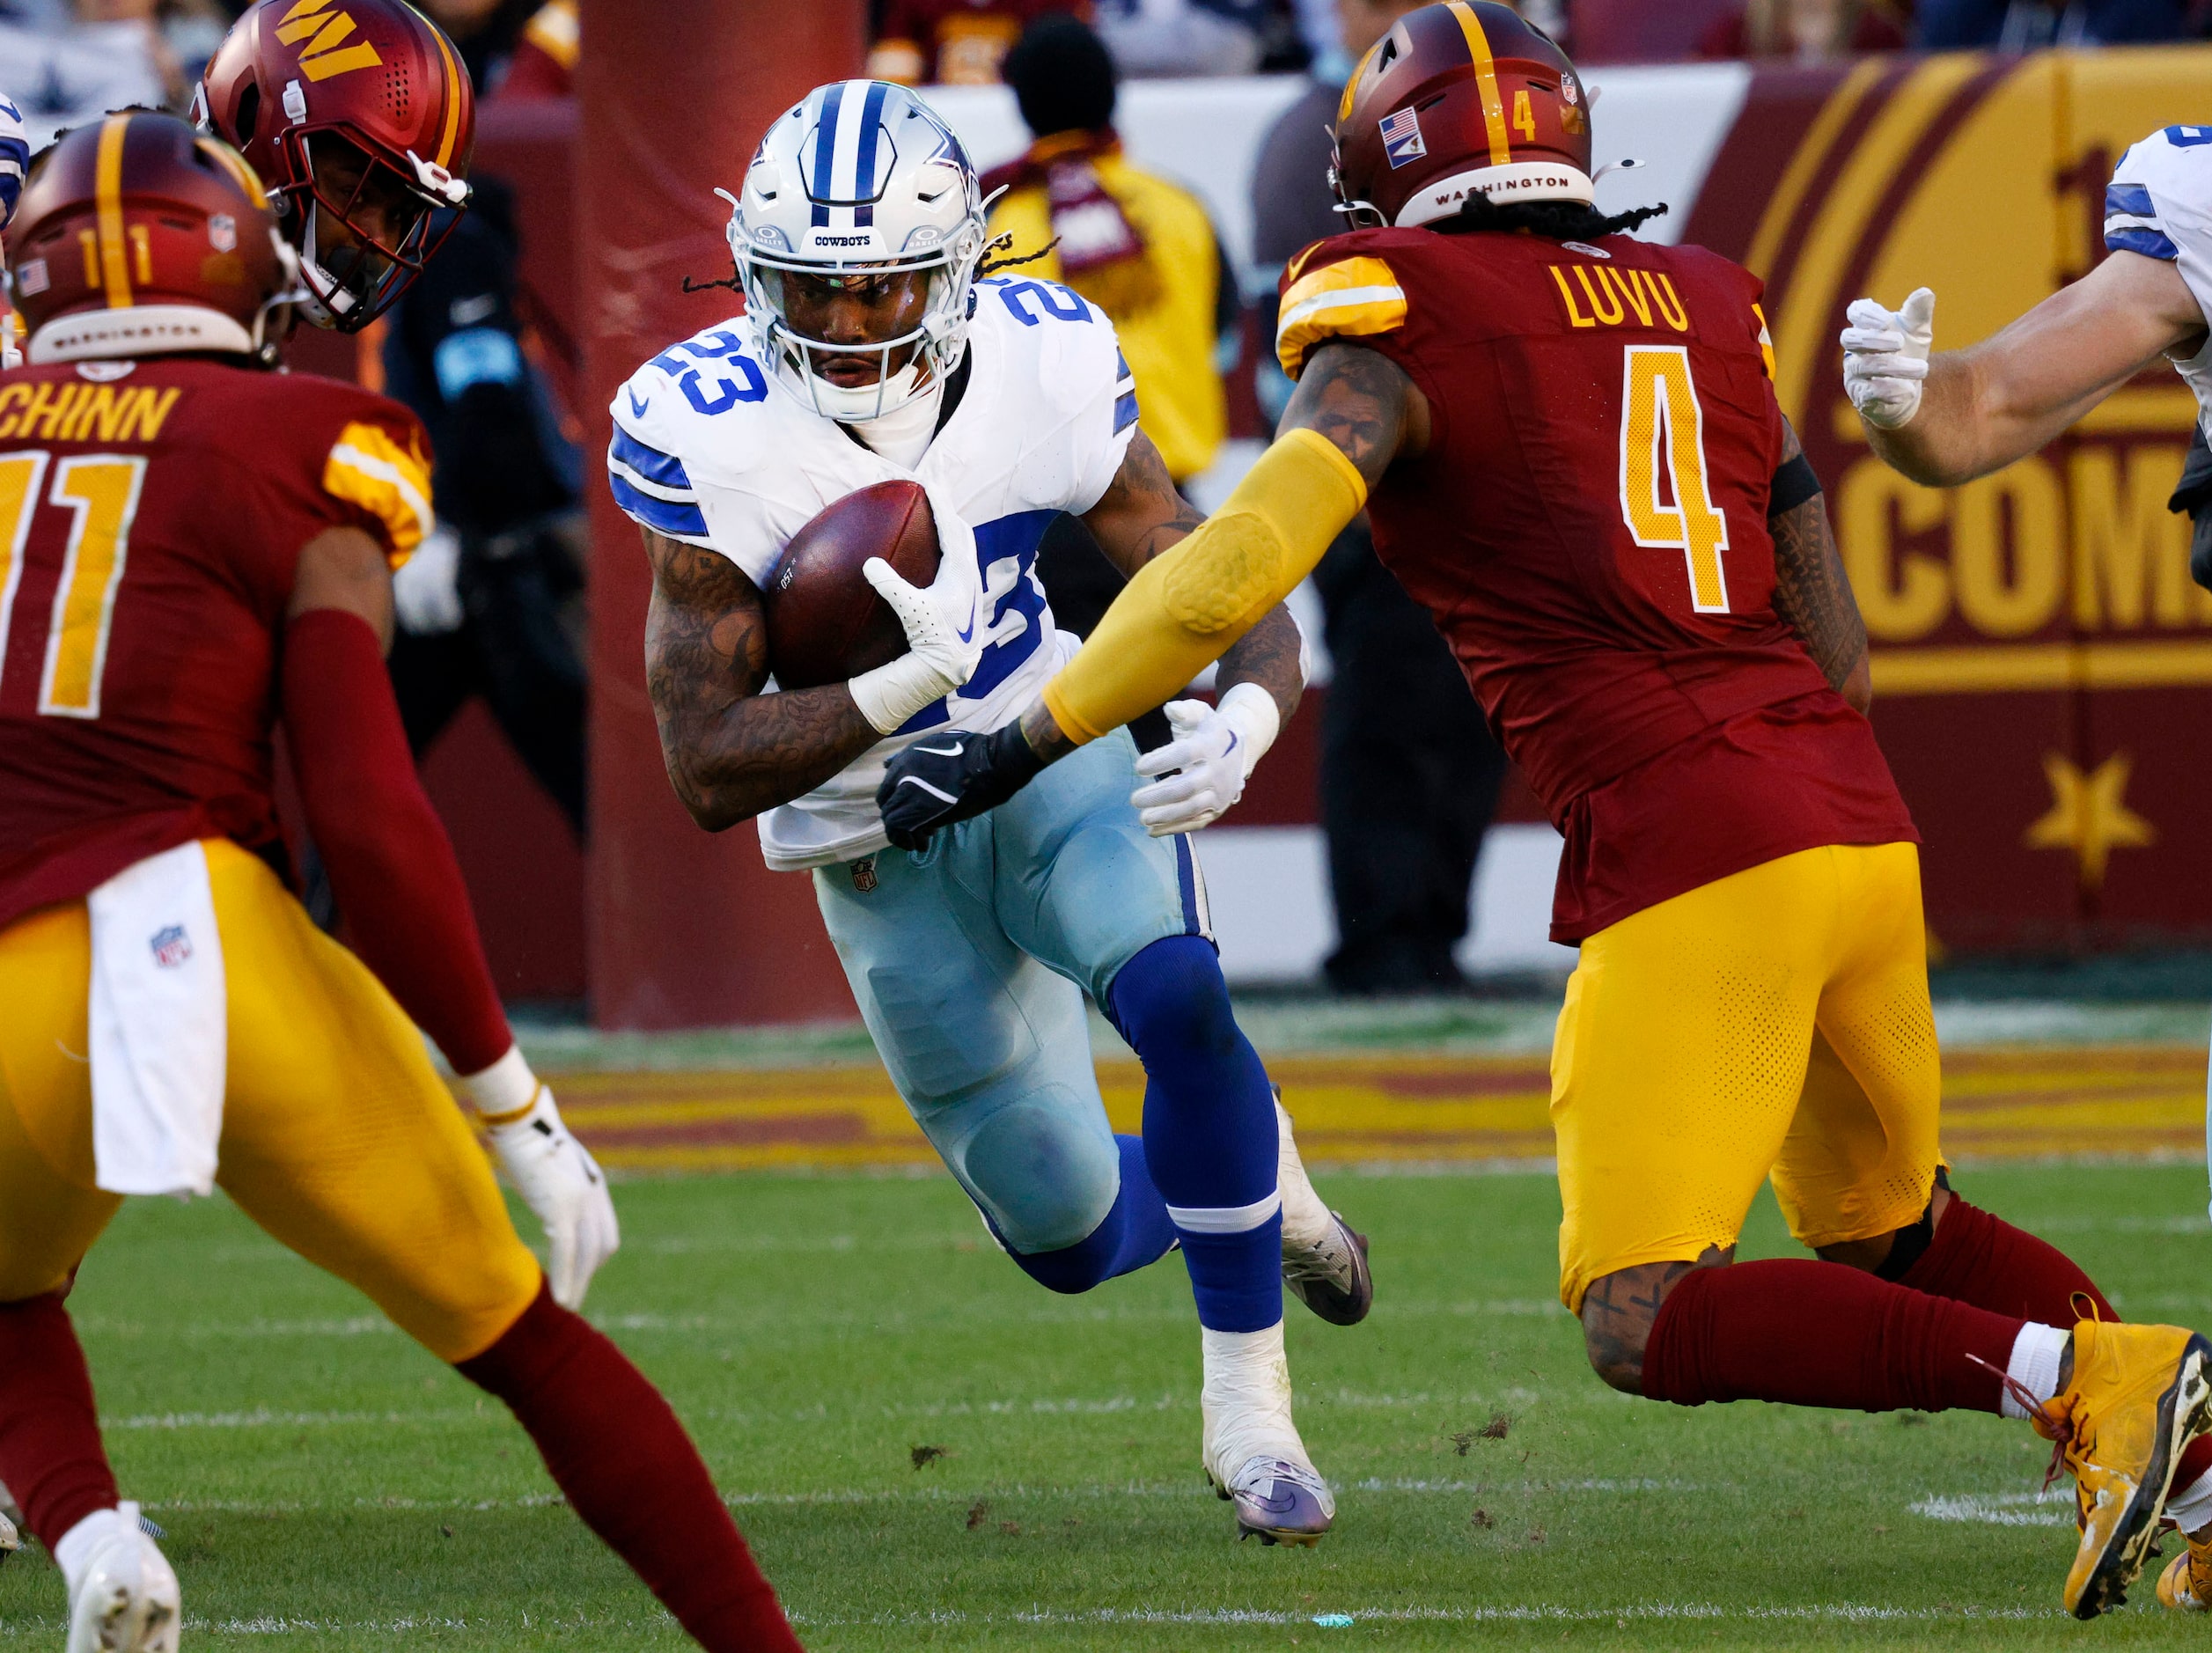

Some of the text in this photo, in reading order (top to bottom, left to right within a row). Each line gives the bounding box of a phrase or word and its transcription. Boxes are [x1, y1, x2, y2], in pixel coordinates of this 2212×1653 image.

[1513, 90, 1535, 141] 4
[77, 224, 152, 289] 11
[815, 235, 871, 246] COWBOYS
[978, 278, 1094, 327] 2
[1548, 265, 1688, 332] LUVU
[647, 331, 768, 416] 23
[0, 381, 182, 442] CHINN
[1620, 344, 1730, 613] 4
[1841, 446, 2212, 641] COM
[889, 509, 1062, 738] 3
